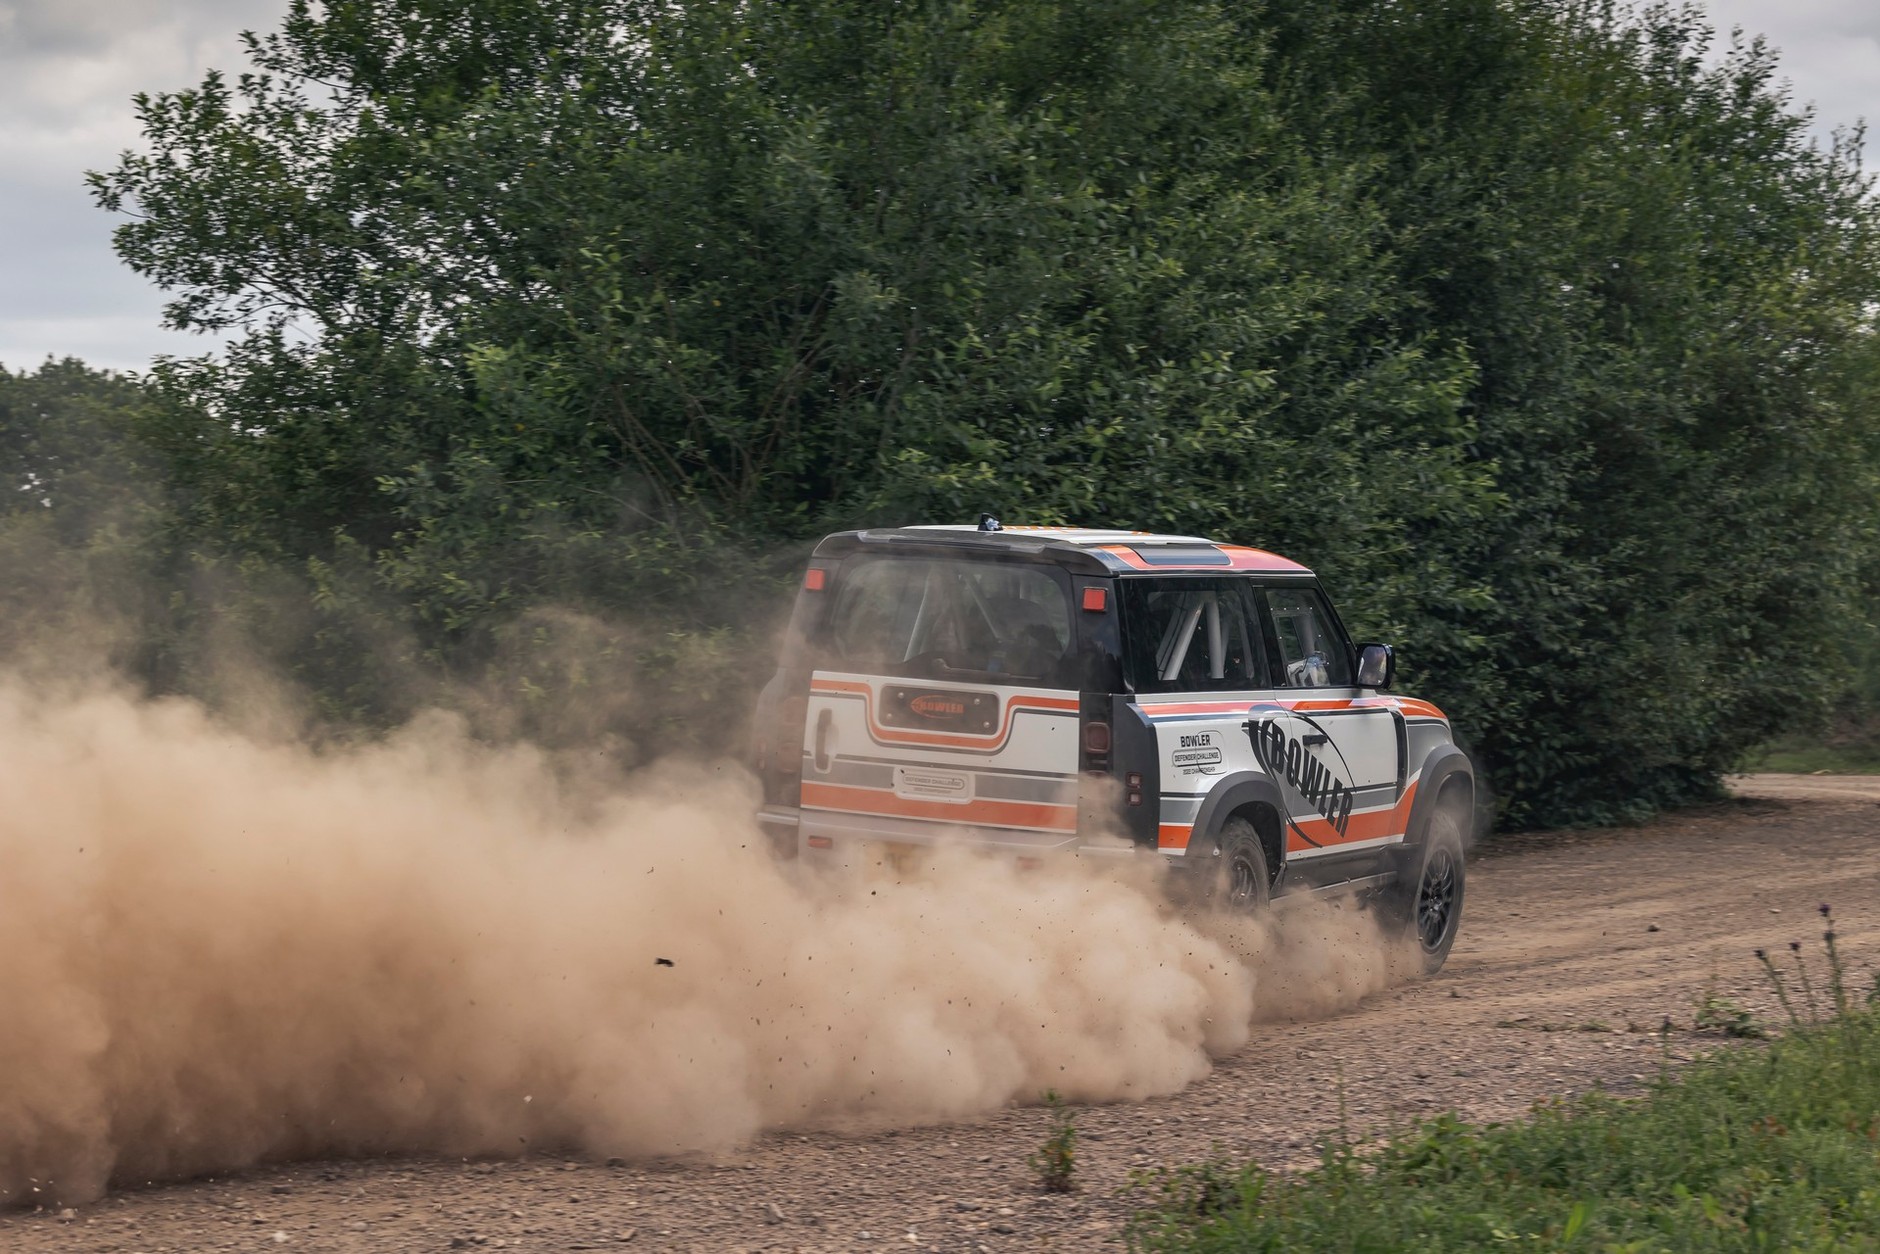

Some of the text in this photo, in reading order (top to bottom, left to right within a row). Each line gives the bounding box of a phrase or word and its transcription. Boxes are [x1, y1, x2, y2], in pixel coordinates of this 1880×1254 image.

[1180, 734, 1211, 748] BOWLER
[1174, 752, 1219, 762] DEFENDER CHALLENGE
[1271, 720, 1353, 838] BOWLER
